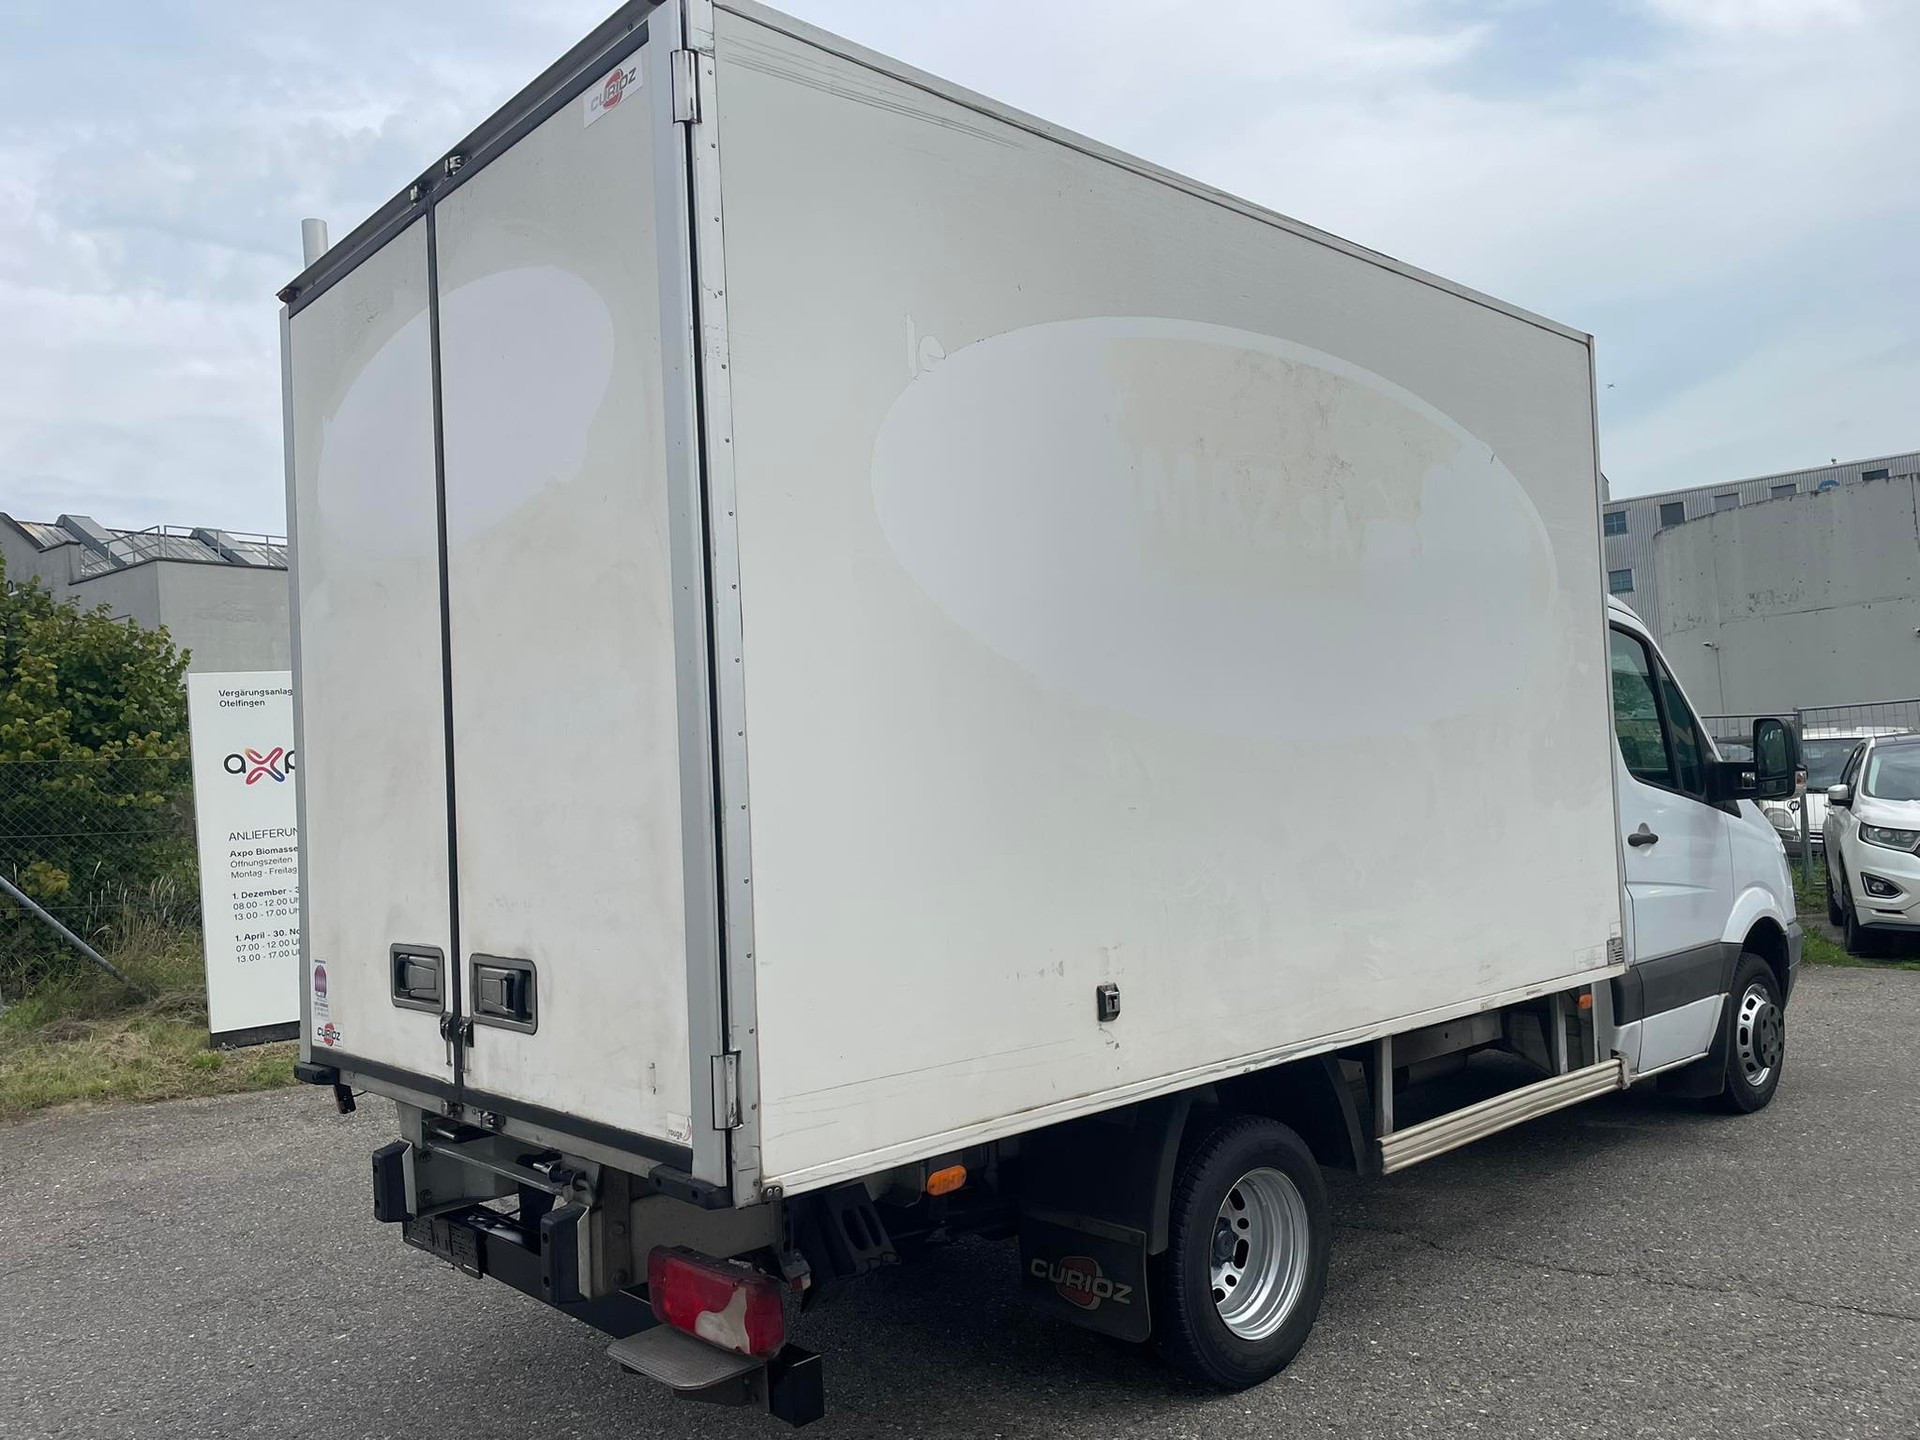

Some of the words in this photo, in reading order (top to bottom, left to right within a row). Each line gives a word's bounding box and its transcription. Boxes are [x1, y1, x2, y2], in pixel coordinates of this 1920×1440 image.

[591, 67, 637, 112] CURIOZ
[219, 699, 265, 708] Otelfingen
[229, 850, 254, 858] Axpo
[230, 870, 263, 879] Montag
[269, 867, 298, 875] Freitag
[232, 892, 239, 900] 1.
[241, 889, 287, 899] Dezember
[235, 934, 242, 942] 1.
[244, 931, 265, 941] April
[273, 929, 287, 938] 30.
[1031, 1258, 1133, 1305] CURIOZ
